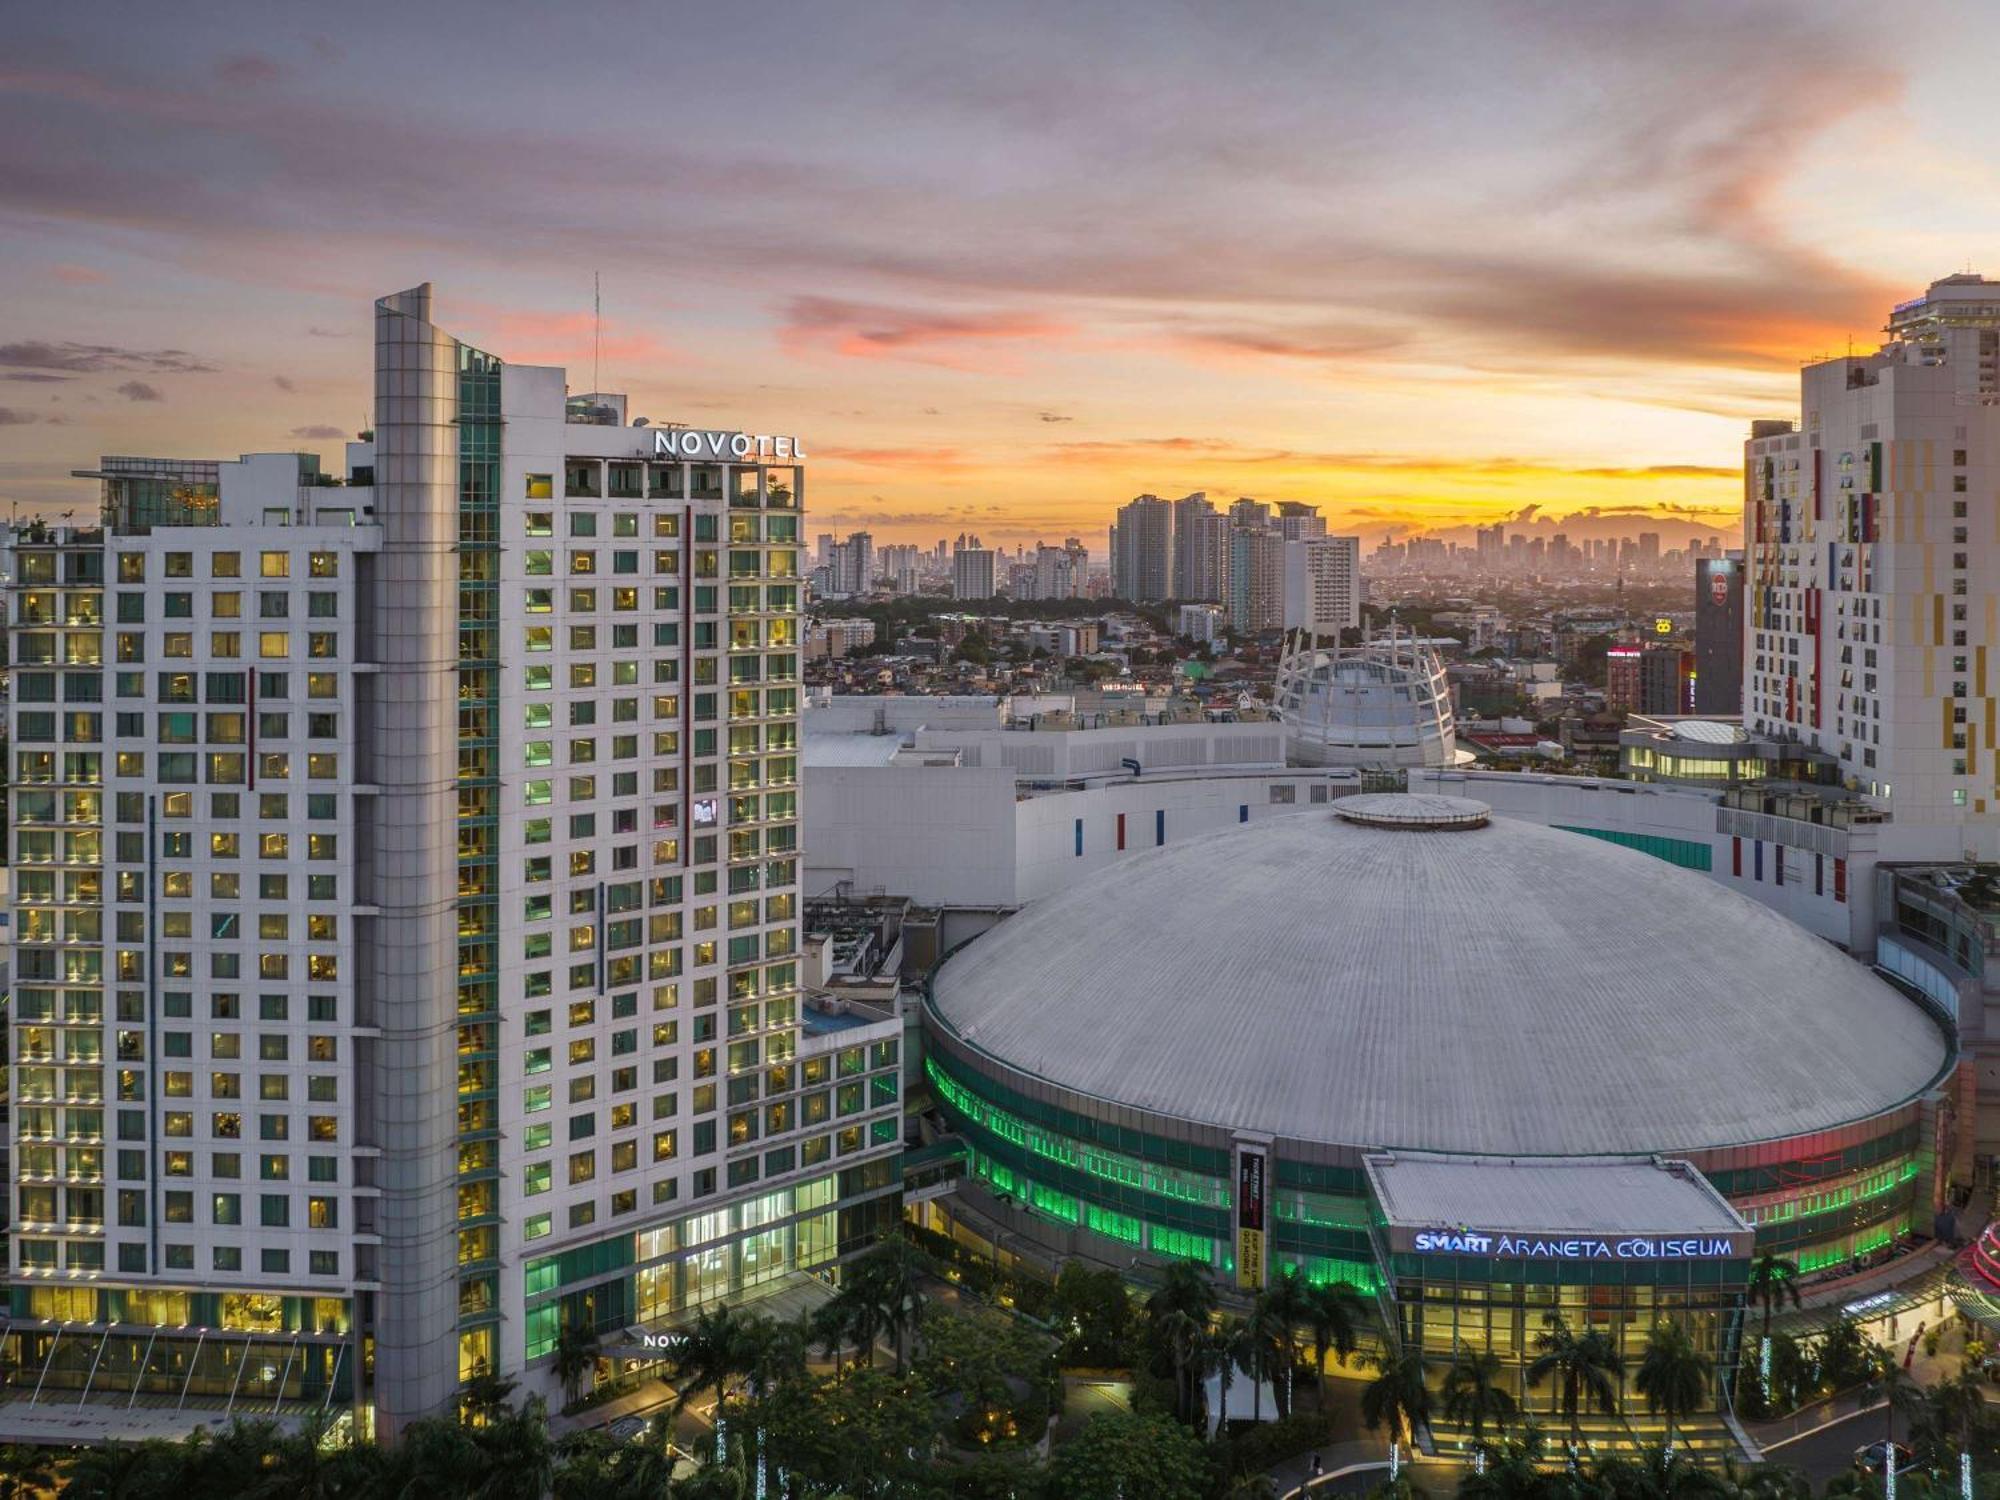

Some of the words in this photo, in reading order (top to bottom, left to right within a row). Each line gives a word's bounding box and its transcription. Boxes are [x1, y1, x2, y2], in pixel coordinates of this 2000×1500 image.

[655, 430, 807, 458] NOVOTEL
[1243, 1230, 1250, 1244] GO
[1415, 1232, 1493, 1253] SMART
[1496, 1235, 1612, 1258] ARANETA
[1617, 1238, 1732, 1258] COLISEUM
